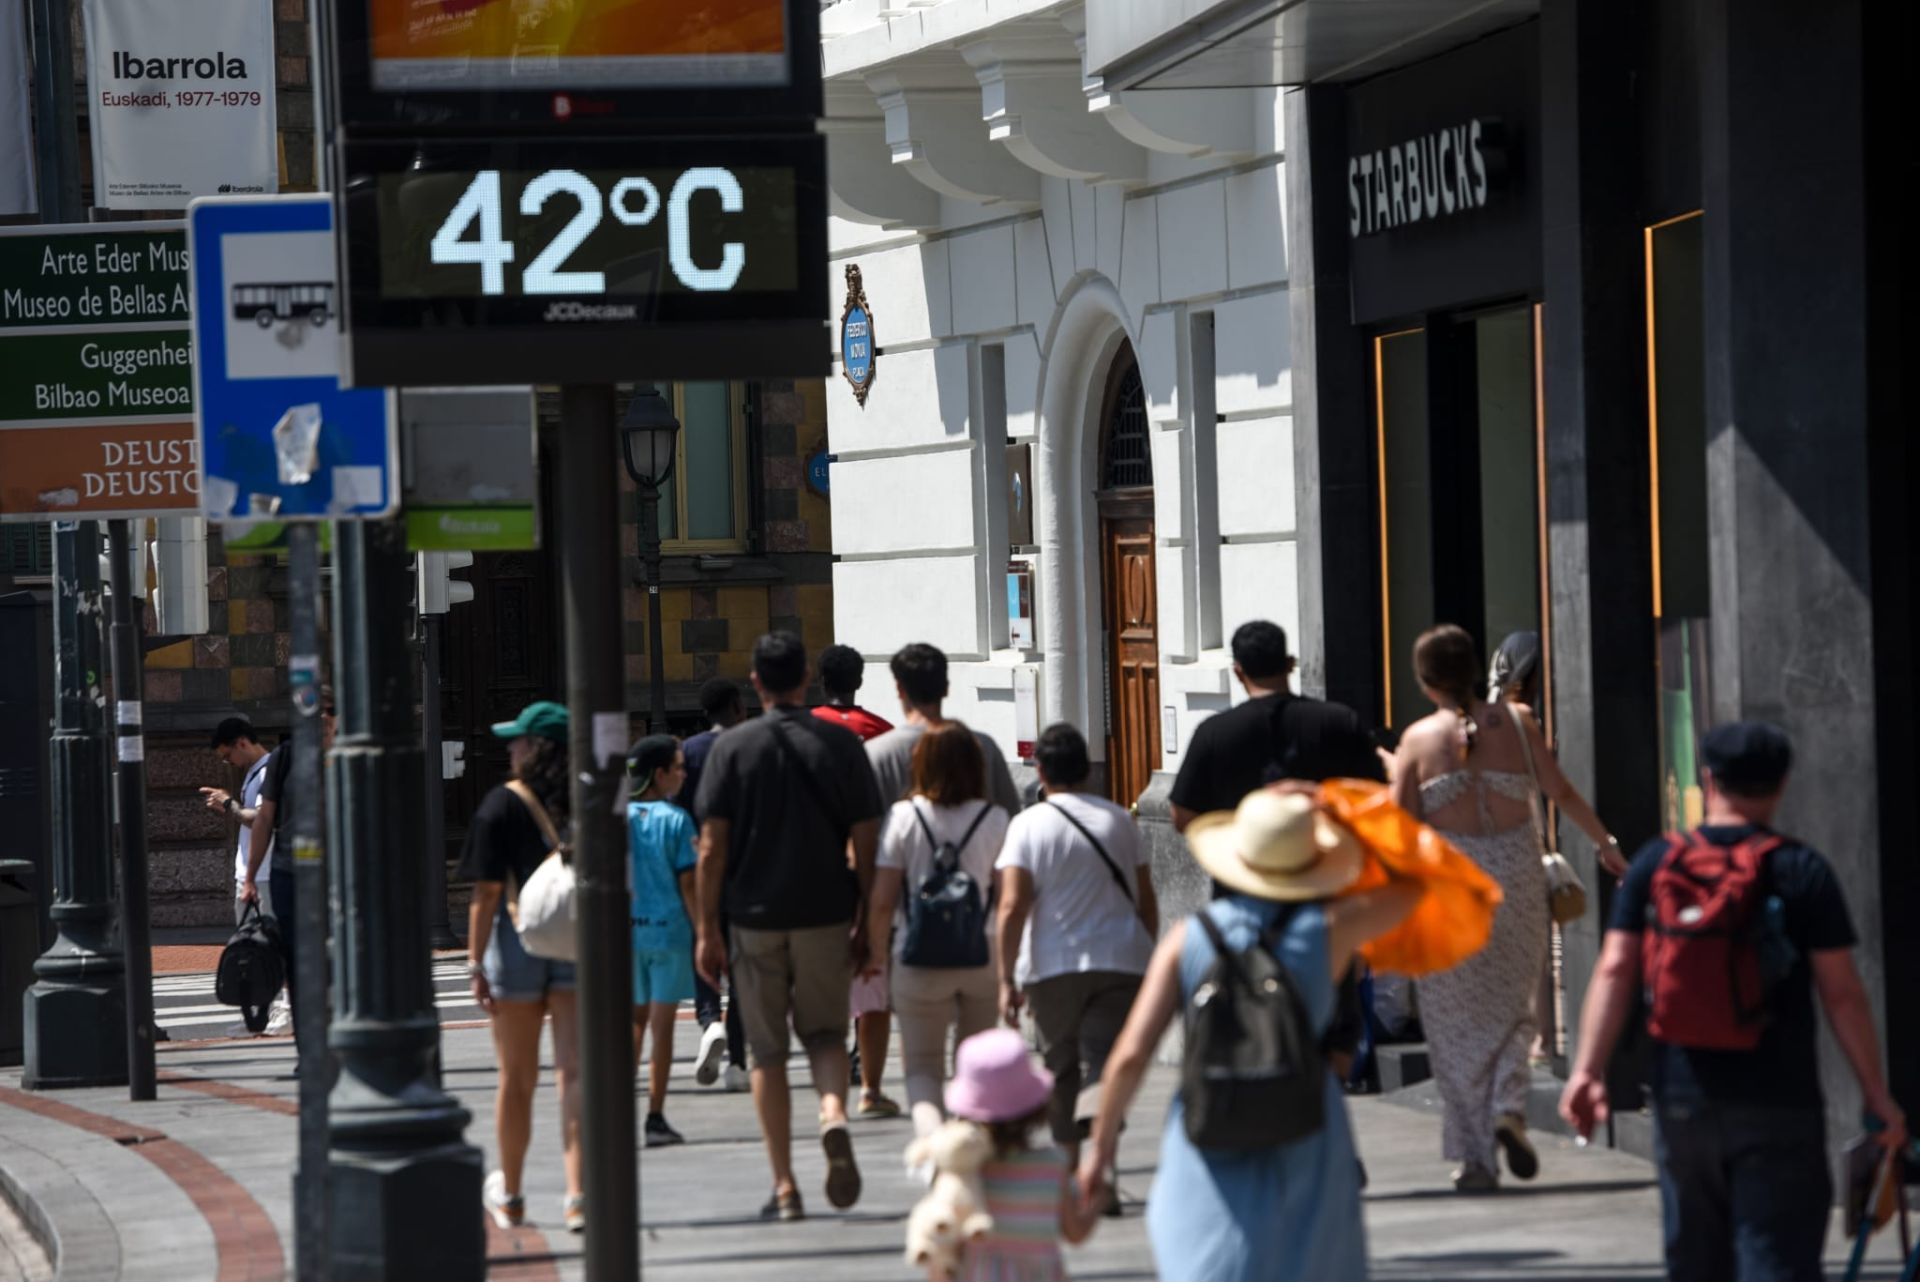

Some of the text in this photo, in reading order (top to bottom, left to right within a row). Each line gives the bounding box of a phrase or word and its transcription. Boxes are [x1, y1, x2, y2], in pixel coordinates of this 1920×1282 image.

[113, 51, 247, 79] Ibarrola
[102, 91, 261, 109] Euskadi, 1977-1979
[1348, 117, 1487, 238] STARBUCKS
[431, 167, 745, 295] 42°C
[41, 245, 88, 275] Arte
[95, 243, 142, 273] Eder
[4, 282, 193, 319] Museo de Bellas A
[35, 381, 190, 409] Bilbao Museoa
